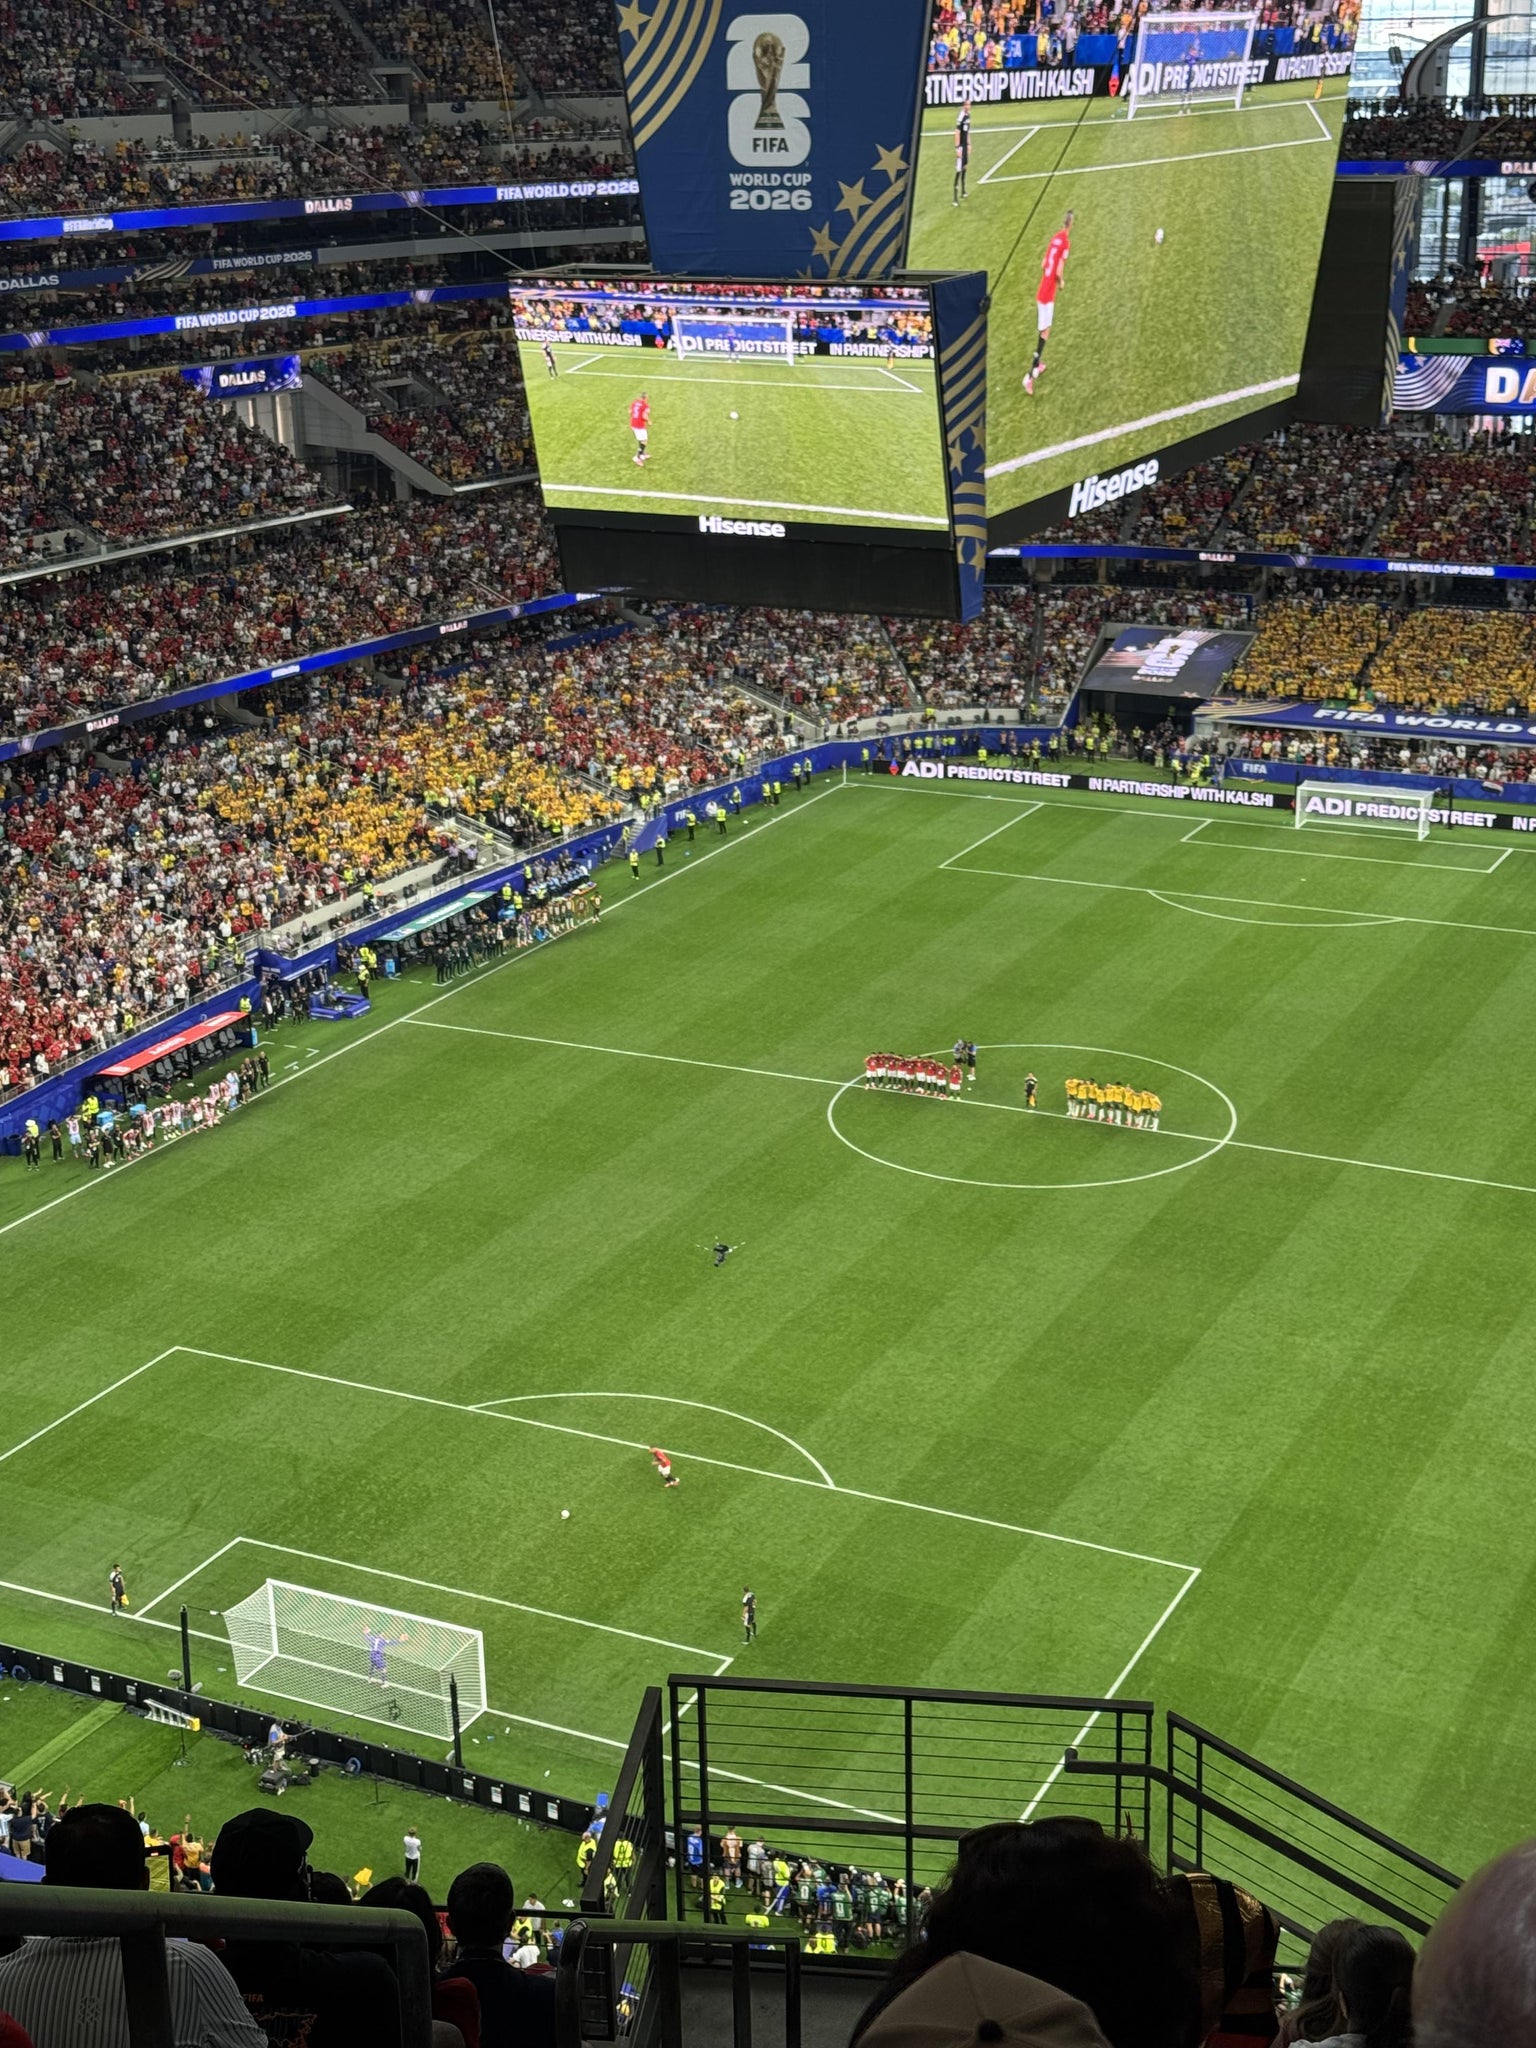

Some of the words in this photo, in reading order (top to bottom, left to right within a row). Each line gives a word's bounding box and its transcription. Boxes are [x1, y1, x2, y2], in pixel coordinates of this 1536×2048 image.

[1275, 57, 1290, 81] IN
[1009, 69, 1048, 99] WITH
[1048, 68, 1095, 97] KALSHI
[752, 138, 789, 153] FIFA
[729, 174, 781, 187] WORLD
[782, 173, 812, 187] CUP
[497, 186, 523, 200] FIFA
[523, 184, 569, 198] WORLD
[570, 182, 595, 196] CUP
[596, 181, 639, 195] 2026
[729, 190, 812, 210] 2026
[304, 198, 352, 214] DALLAS
[213, 259, 233, 270] FIFA
[233, 255, 264, 268] WORLD
[265, 253, 282, 265] CUP
[283, 251, 312, 263] 2026
[0, 275, 60, 291] DALLAS
[175, 315, 199, 330] FIFA
[200, 312, 238, 327] WORLD
[238, 308, 259, 323] CUP
[259, 304, 296, 320] 2026
[573, 331, 603, 344] WITH
[603, 332, 642, 346] KALSHI
[829, 343, 842, 356] IN
[219, 370, 266, 388] DALLAS
[1068, 458, 1159, 518] Hisense
[699, 515, 786, 537] Hisense
[1387, 561, 1408, 572] FIFA
[1408, 562, 1441, 574] WORLD
[1441, 564, 1460, 574] CUP
[86, 714, 119, 732] DALLAS
[1313, 709, 1386, 724] FIFA
[1395, 715, 1524, 733] WORLD
[902, 761, 945, 779] ADI
[947, 765, 1072, 788] PREDICTSTREET
[1242, 763, 1267, 775] FIFA
[1089, 777, 1103, 791] IN
[1103, 778, 1190, 799] PARTNERSHIP
[1190, 786, 1225, 803] WITH
[1225, 790, 1274, 807] KALSHI
[1305, 796, 1352, 816] ADI
[1355, 801, 1498, 828] PREDICTSTREET
[1512, 816, 1528, 831] IN
